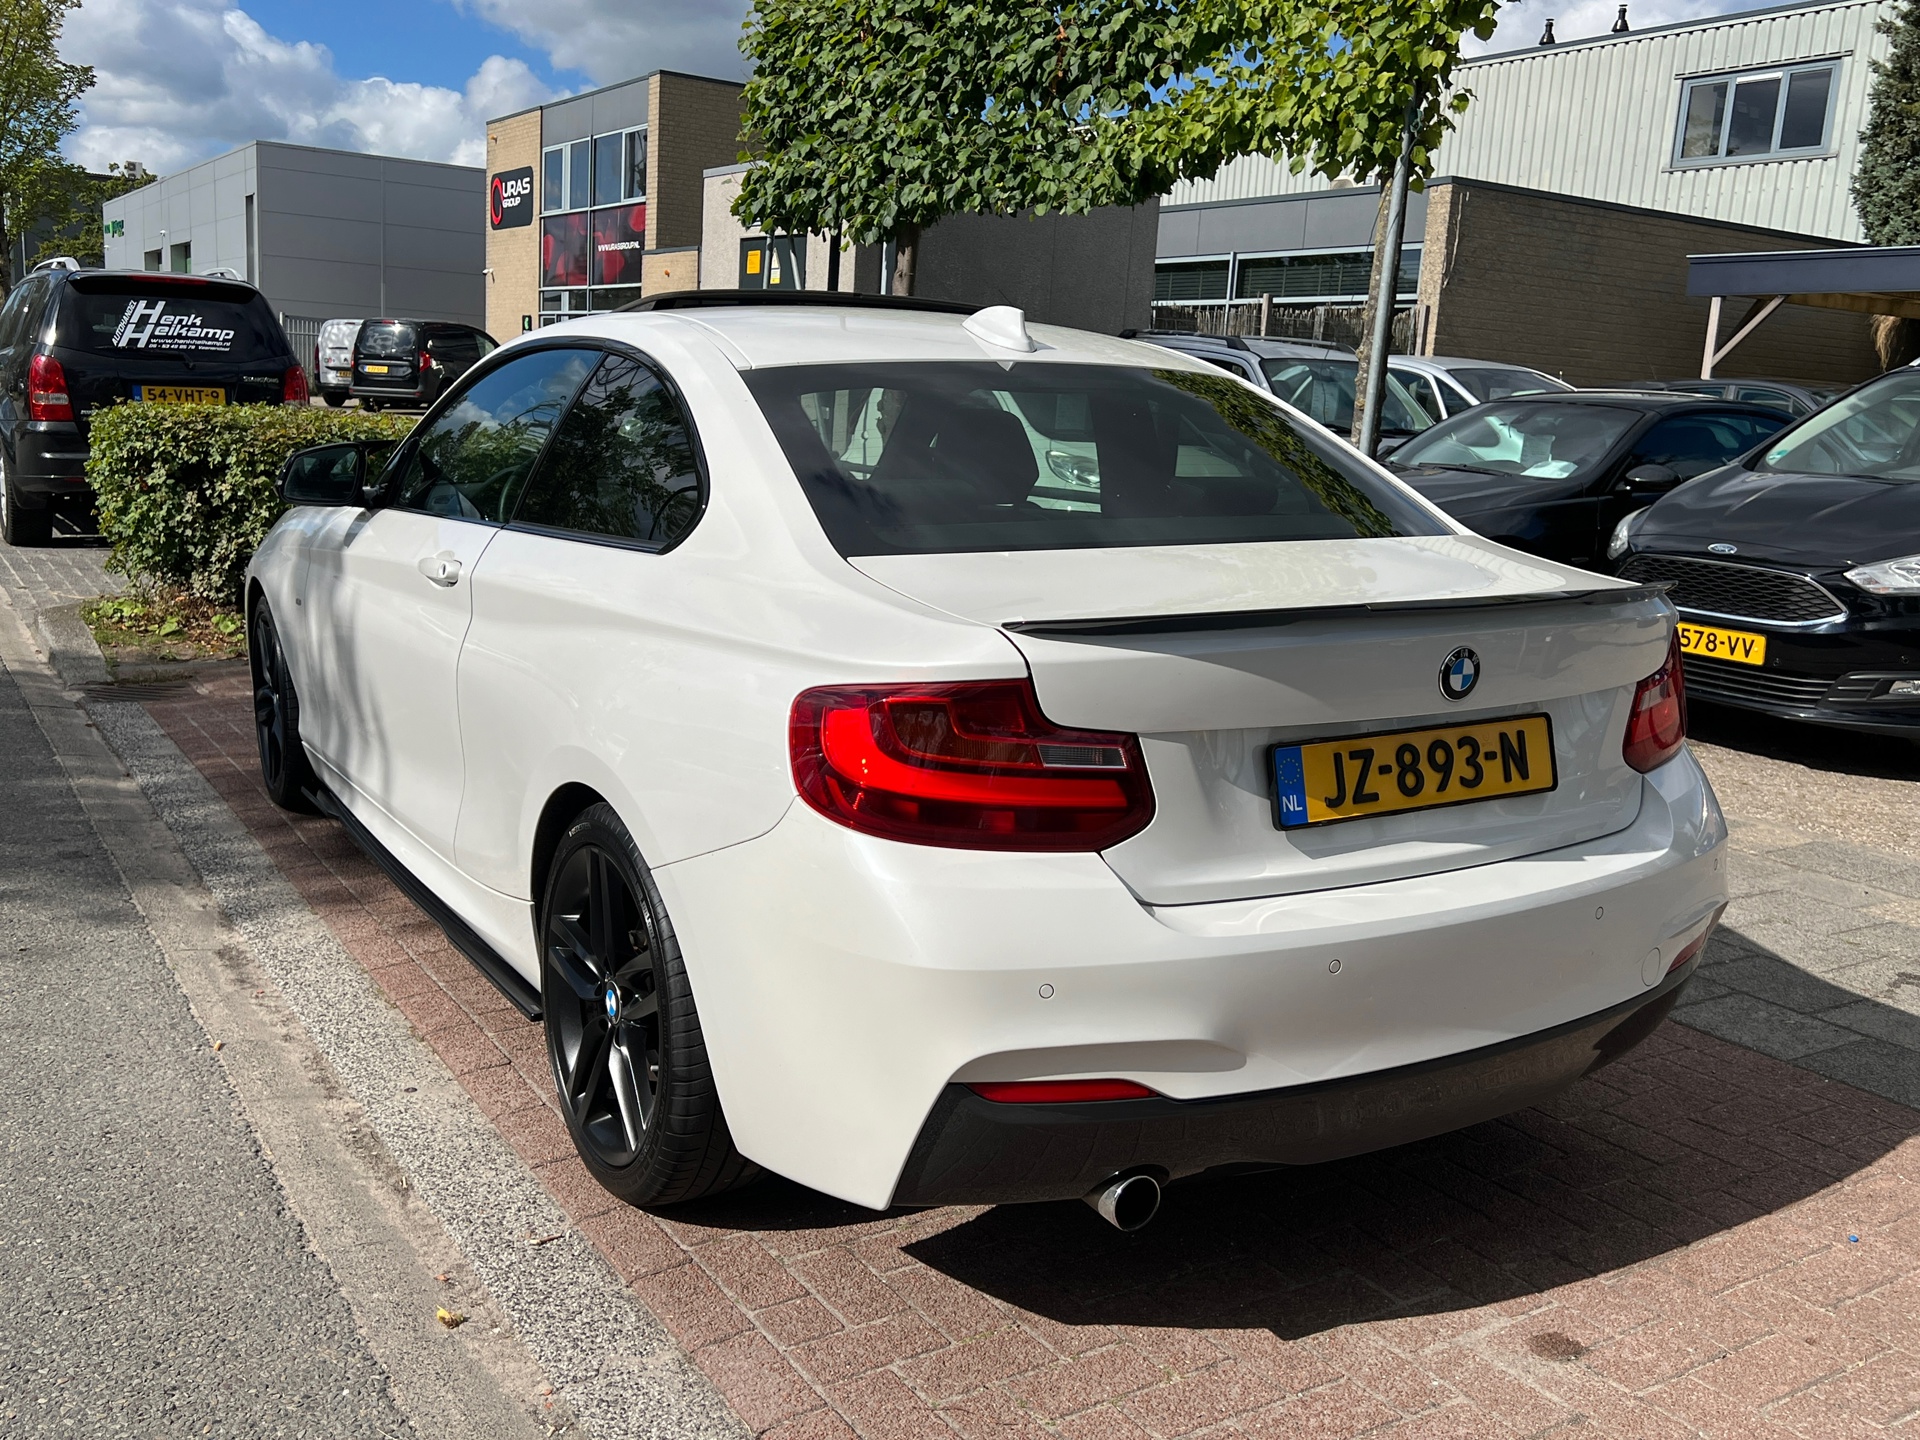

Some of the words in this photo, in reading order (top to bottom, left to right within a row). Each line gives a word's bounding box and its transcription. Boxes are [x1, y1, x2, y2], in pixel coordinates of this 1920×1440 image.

[503, 197, 521, 208] GROUP
[111, 300, 137, 347] AUTOHANDEL
[129, 300, 202, 326] Henk
[148, 388, 220, 402] 54-VHT-9
[1325, 730, 1530, 809] JZ-893-N
[1282, 795, 1303, 813] NL
